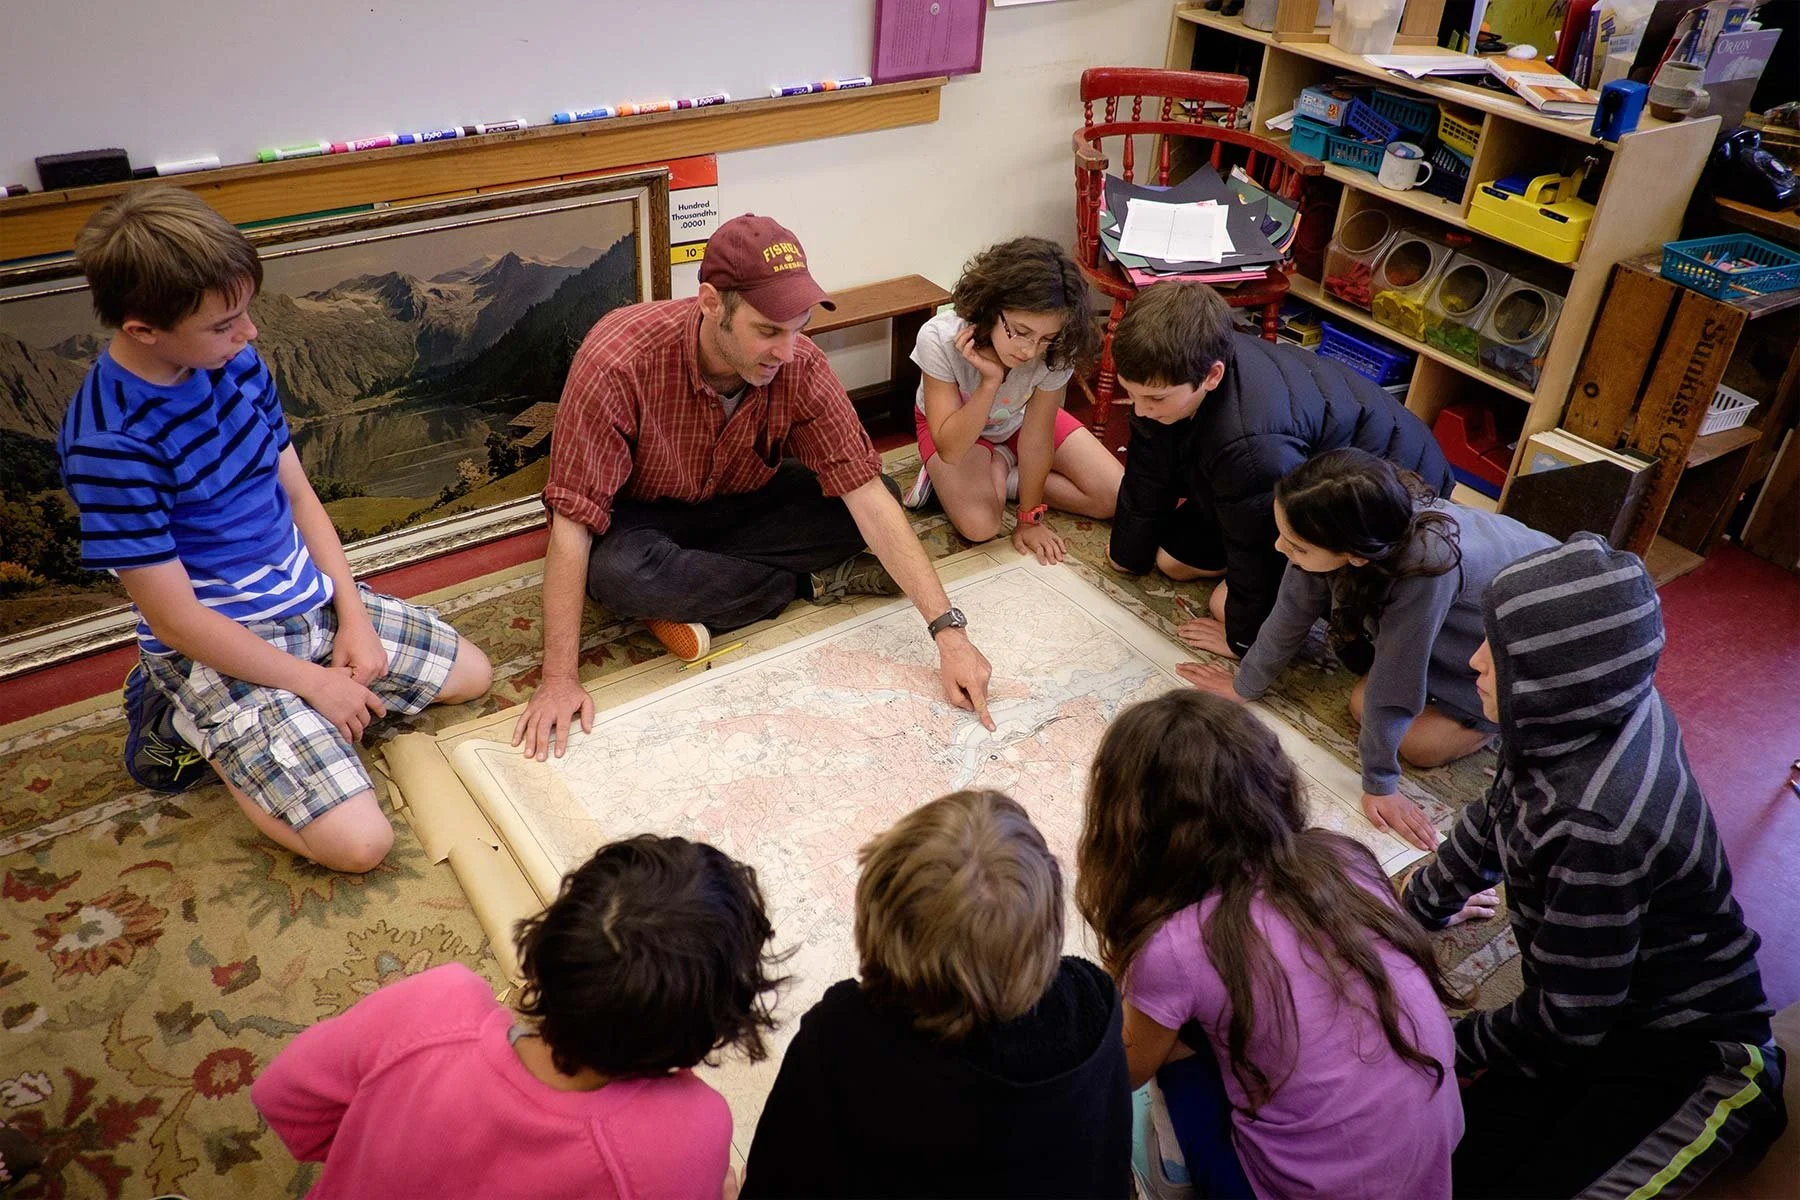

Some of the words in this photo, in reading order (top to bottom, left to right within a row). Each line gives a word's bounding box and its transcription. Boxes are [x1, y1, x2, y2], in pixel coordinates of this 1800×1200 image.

[678, 201, 710, 211] Hundred
[671, 209, 717, 221] Thousandths
[680, 220, 706, 229] .00001
